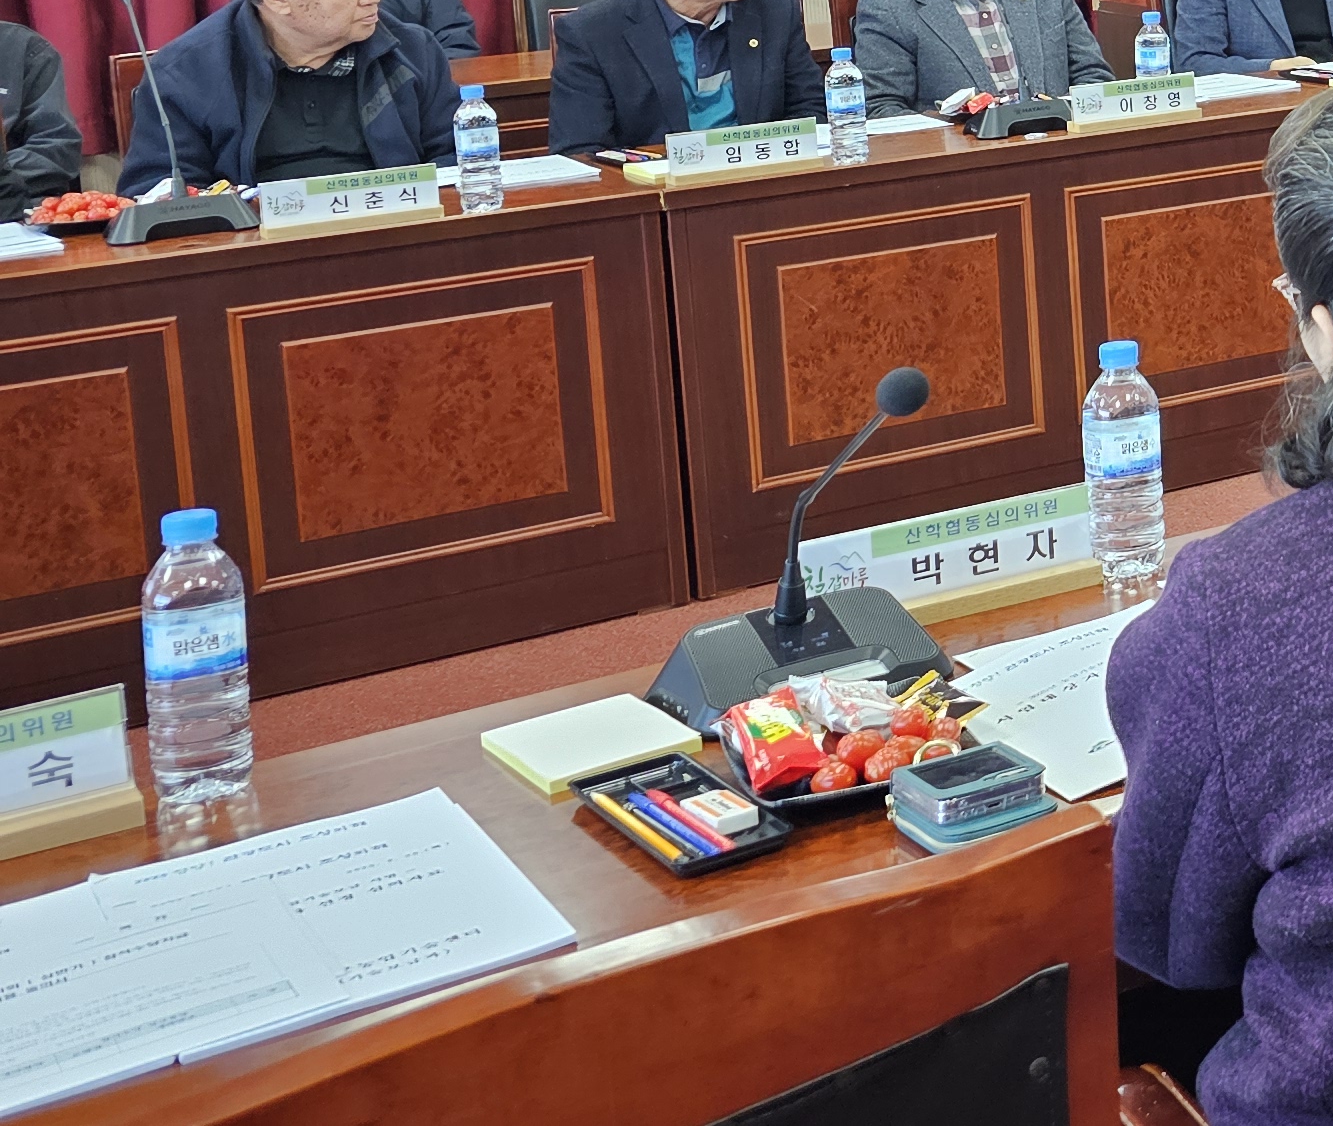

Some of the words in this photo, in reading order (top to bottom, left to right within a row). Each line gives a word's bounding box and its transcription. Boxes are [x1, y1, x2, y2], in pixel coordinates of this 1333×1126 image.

[722, 124, 801, 142] 산학협동심의위원
[326, 170, 419, 190] 산학협동심의위원
[904, 497, 1060, 545] 산학협동심의위원
